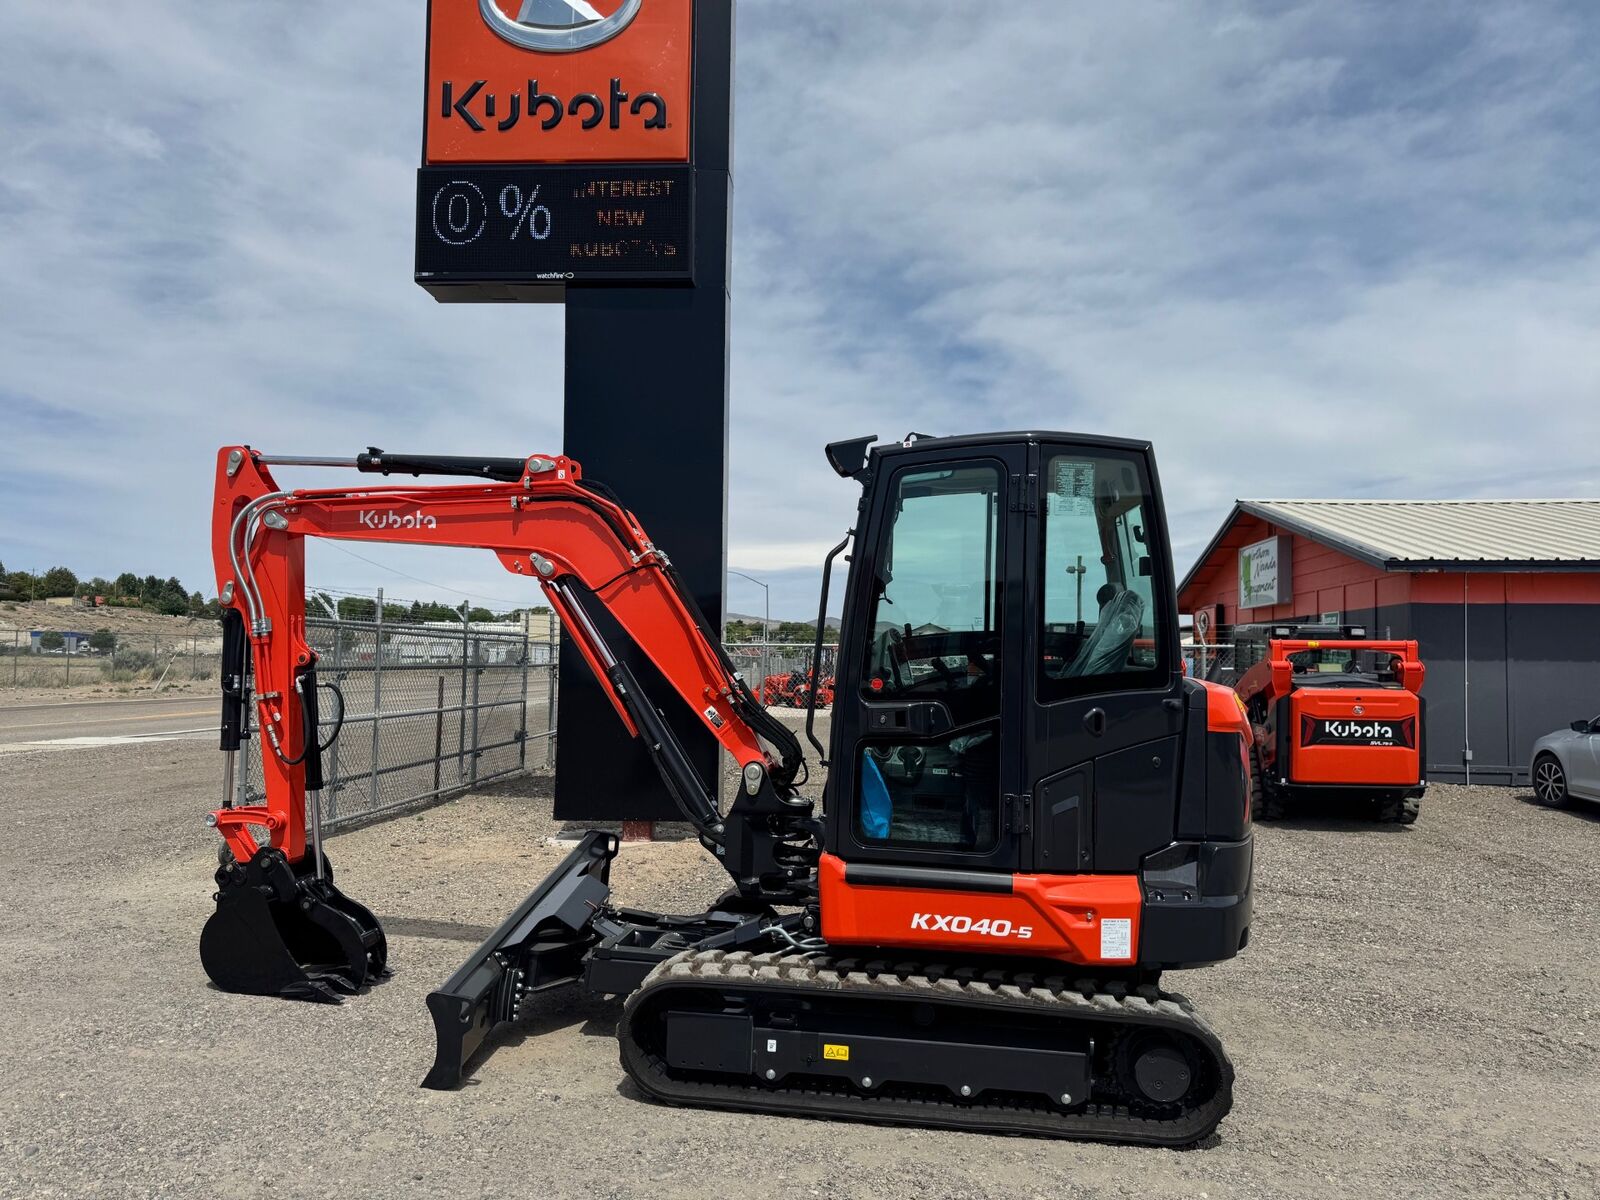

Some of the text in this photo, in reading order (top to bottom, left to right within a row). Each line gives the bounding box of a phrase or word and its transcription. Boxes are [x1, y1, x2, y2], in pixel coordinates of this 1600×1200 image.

[441, 77, 667, 131] Kubota
[597, 209, 645, 226] NEW
[360, 510, 436, 529] Kubota
[1325, 721, 1392, 738] Kubota
[910, 913, 1033, 939] KX040-5
